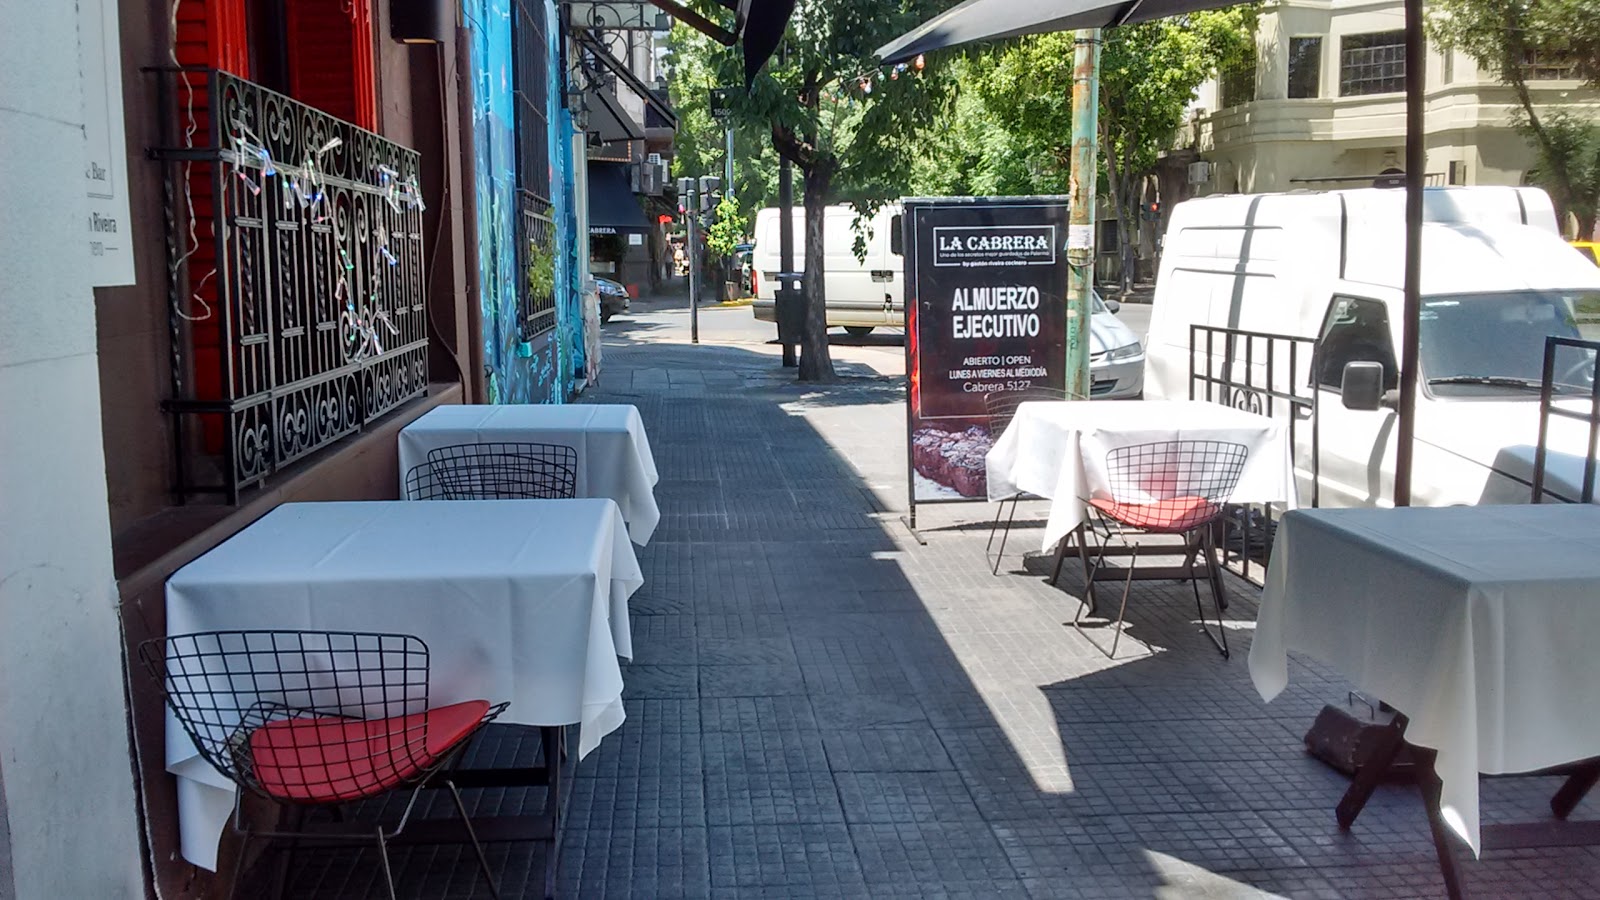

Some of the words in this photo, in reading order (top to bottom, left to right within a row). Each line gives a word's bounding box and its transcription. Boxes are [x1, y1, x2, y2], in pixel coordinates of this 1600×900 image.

[91, 162, 106, 181] Bar
[93, 211, 117, 233] Riveira
[939, 237, 963, 251] LA
[967, 235, 1048, 251] CABRERA
[951, 286, 1040, 311] ALMUERZO
[953, 313, 1040, 339] EJECUTIVO
[963, 356, 1000, 366] ABIERTO
[1006, 355, 1032, 365] OPEN
[949, 369, 971, 379] LUNES
[971, 369, 977, 378] A
[977, 368, 1006, 378] VIERNES
[1006, 368, 1015, 377] AL
[963, 381, 1005, 392] Cabrera
[1006, 380, 1031, 391] 5127
